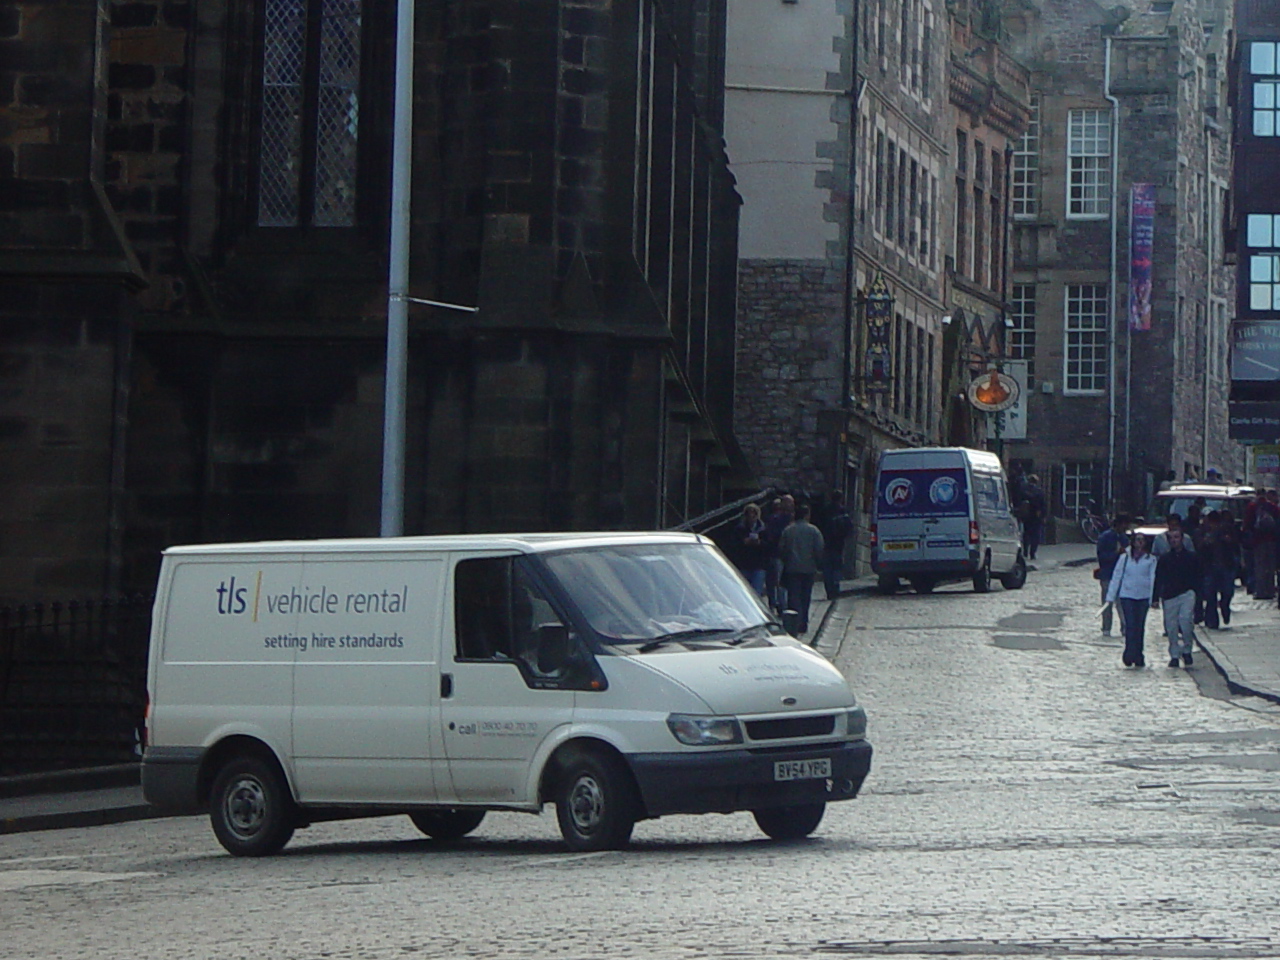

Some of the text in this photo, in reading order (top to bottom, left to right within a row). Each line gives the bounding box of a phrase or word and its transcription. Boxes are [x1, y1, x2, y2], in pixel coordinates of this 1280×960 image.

[216, 576, 408, 614] tls vehicle rental
[264, 632, 404, 652] setting hire standards
[458, 723, 476, 735] call
